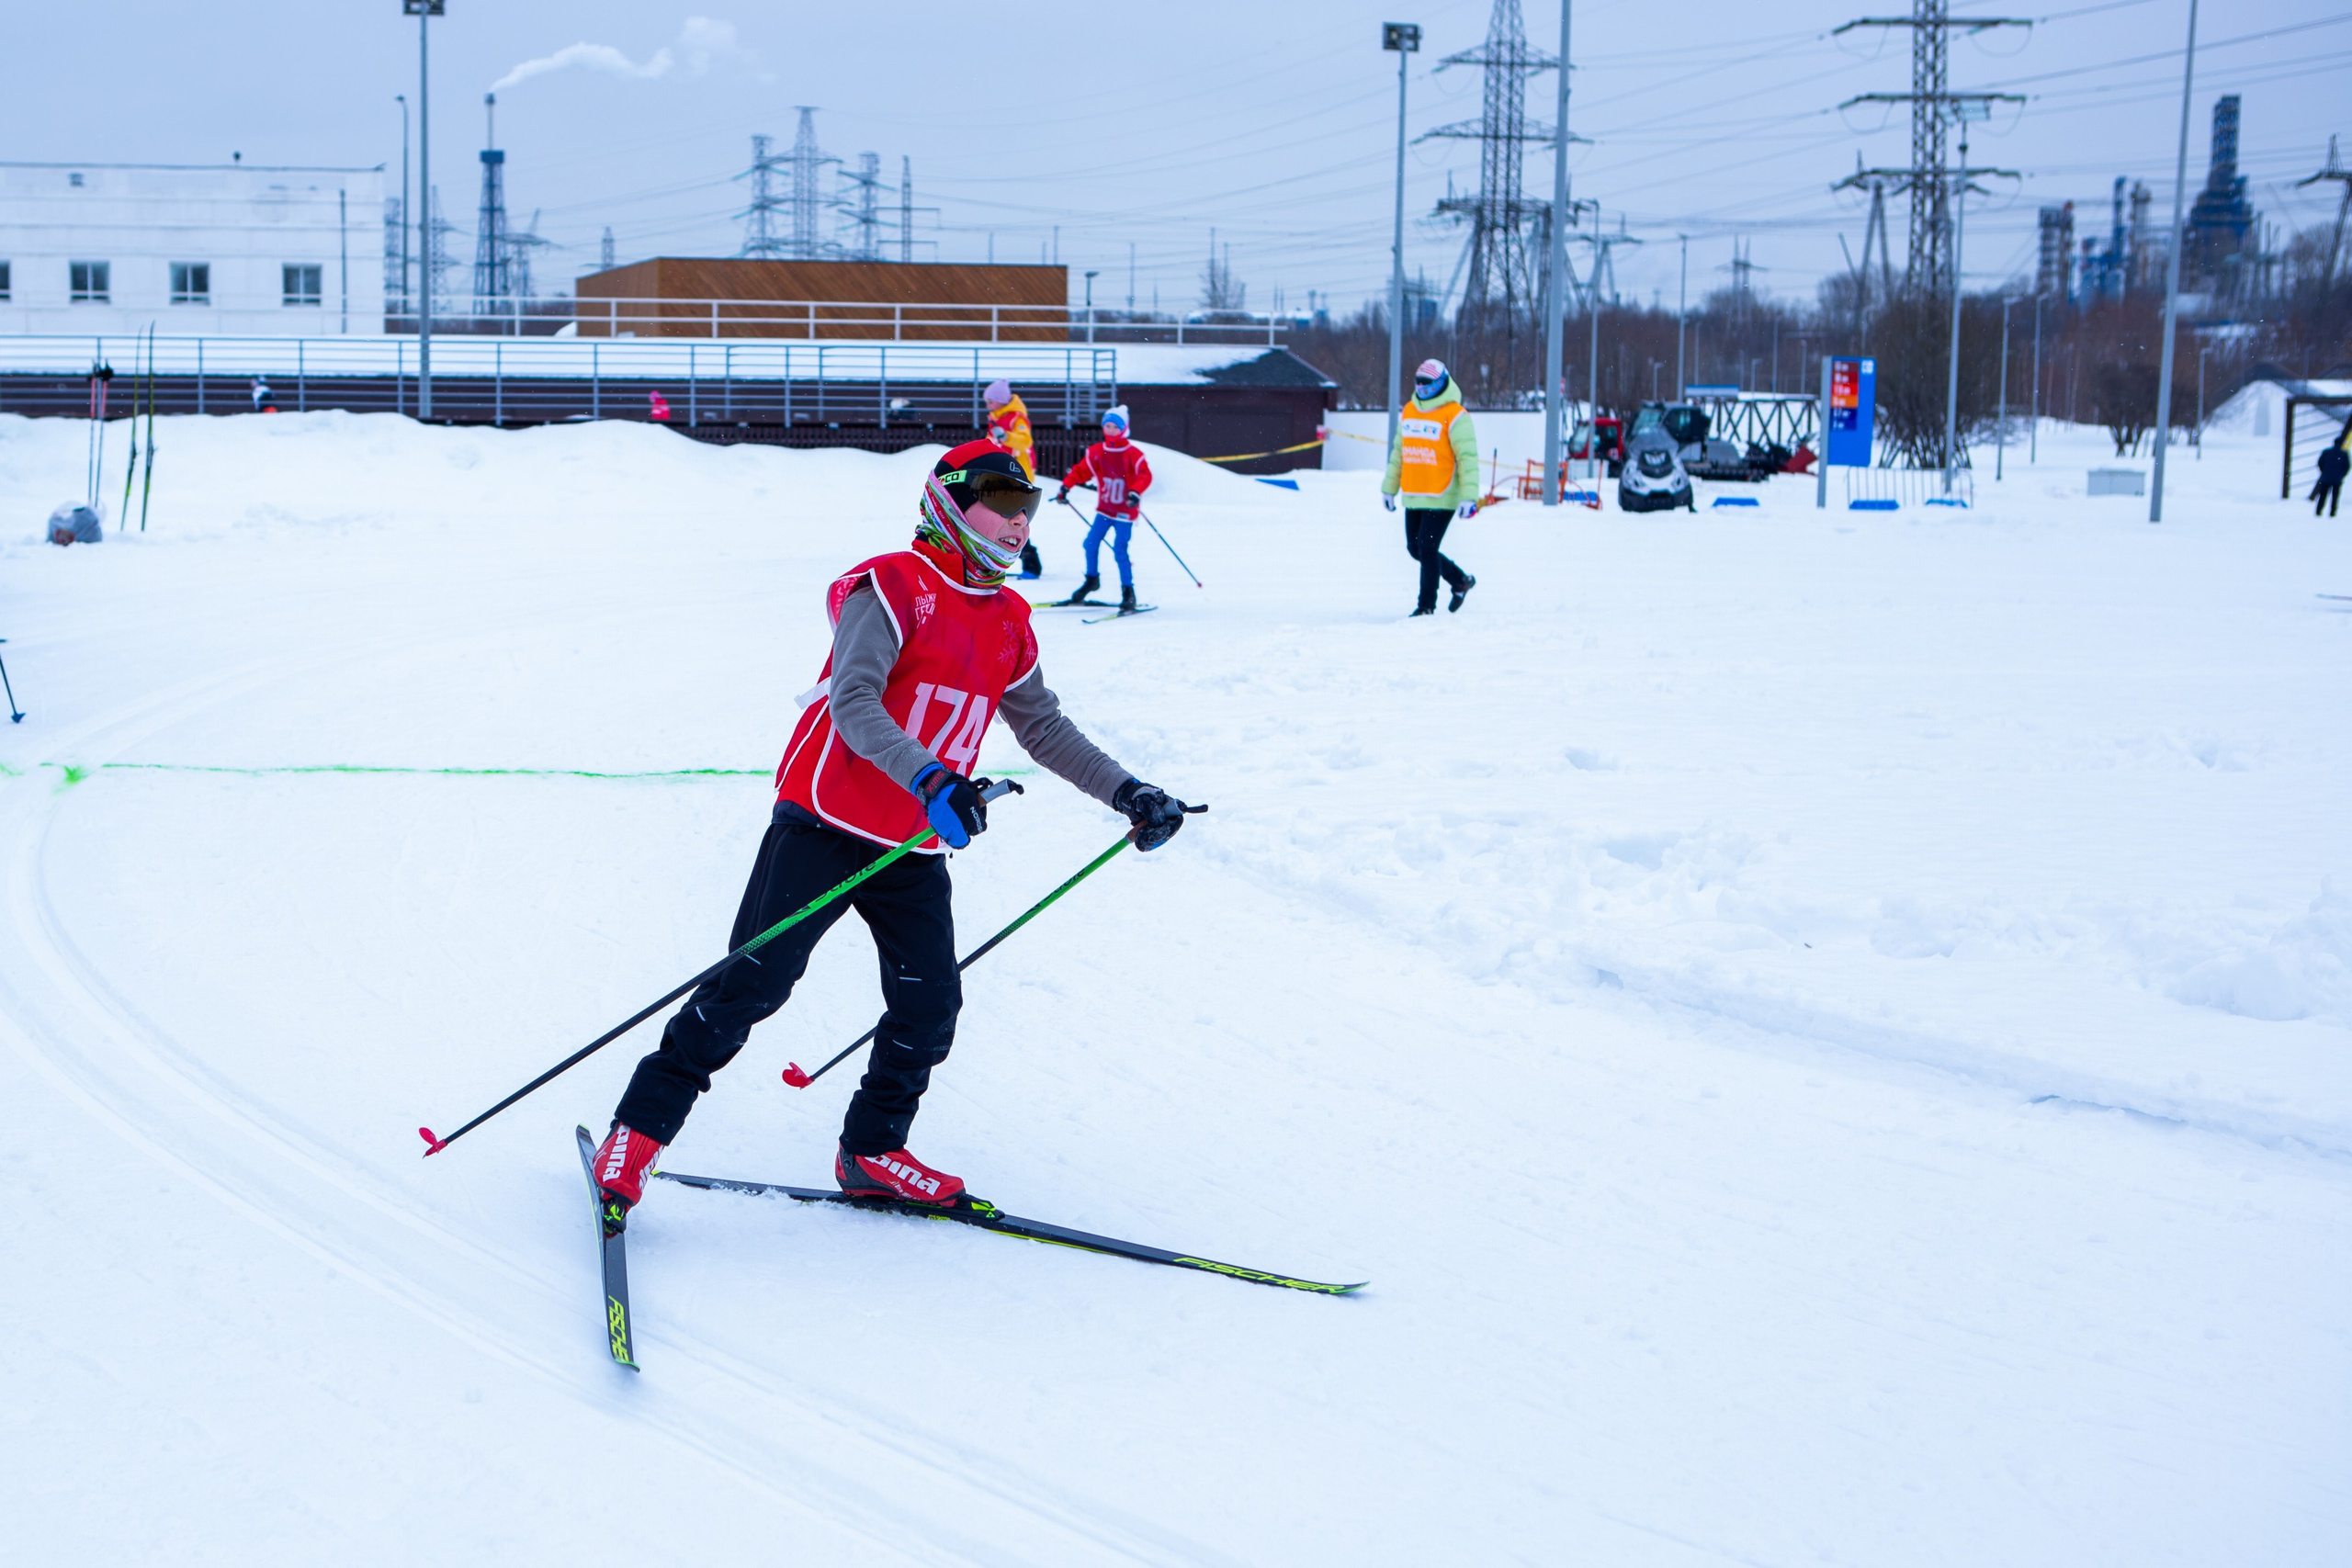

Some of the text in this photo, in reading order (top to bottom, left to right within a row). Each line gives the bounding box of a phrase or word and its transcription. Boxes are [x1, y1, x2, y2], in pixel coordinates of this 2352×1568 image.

[904, 682, 989, 777] 174
[1173, 1257, 1345, 1293] FISCHER
[607, 1294, 631, 1363] FISCHE
